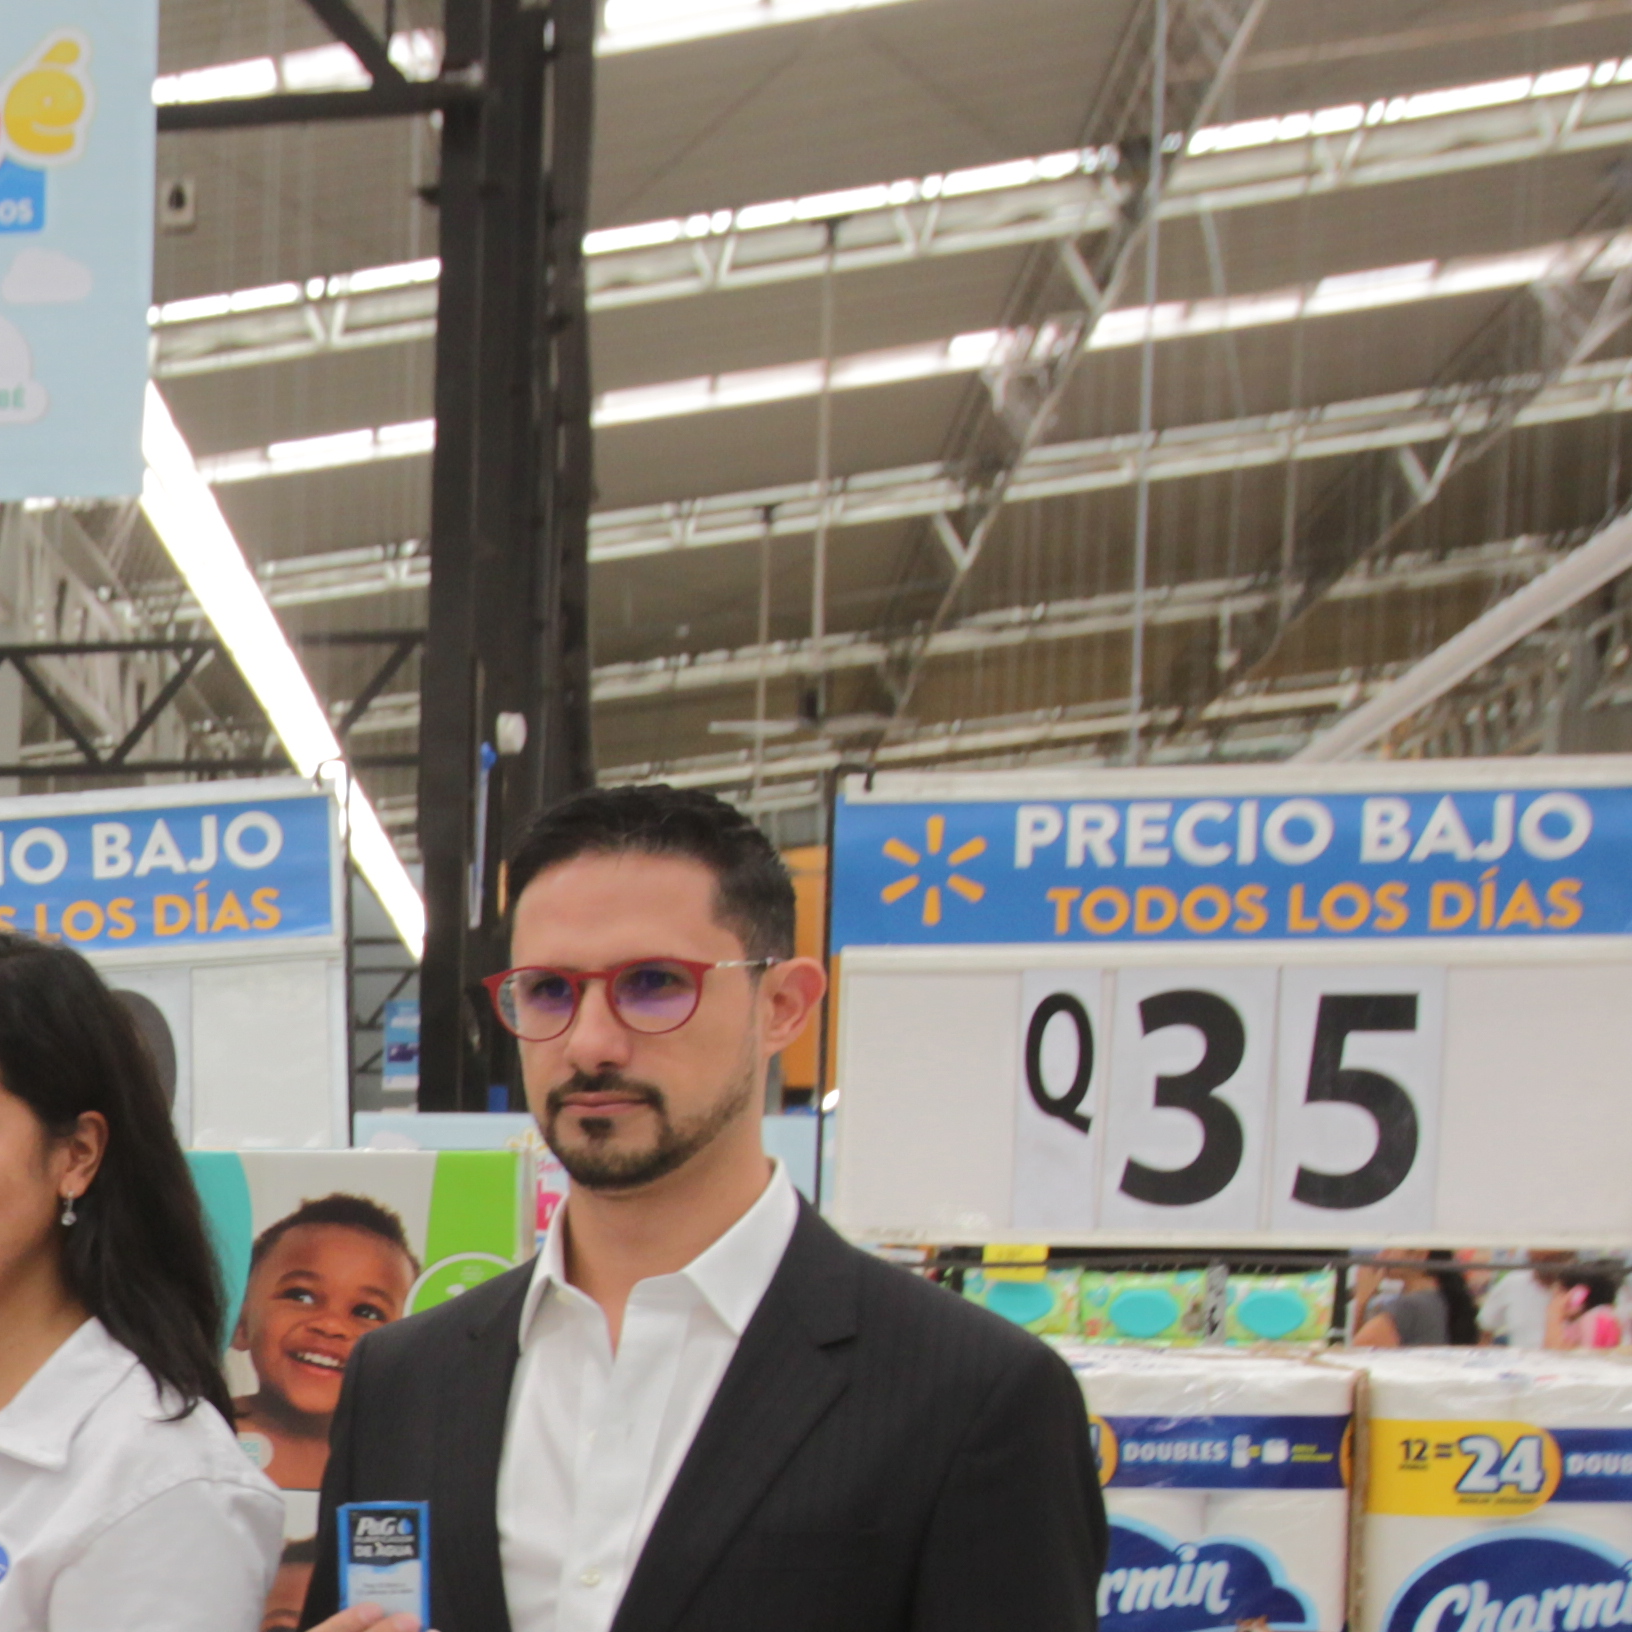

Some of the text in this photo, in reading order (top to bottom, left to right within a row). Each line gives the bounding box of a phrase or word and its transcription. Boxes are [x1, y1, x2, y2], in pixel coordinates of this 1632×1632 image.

[92, 810, 284, 879] BAJO
[1014, 791, 1594, 870] PRECIO BAJO
[36, 897, 137, 942] LOS
[153, 878, 282, 936] DÍAS
[1047, 865, 1585, 935] TODOS LOS DÍAS
[1122, 1439, 1229, 1463] DOUBLES
[1400, 1438, 1428, 1462] 12
[1454, 1434, 1544, 1493] 24
[355, 1516, 398, 1536] P&G
[1096, 1542, 1232, 1616] rmin
